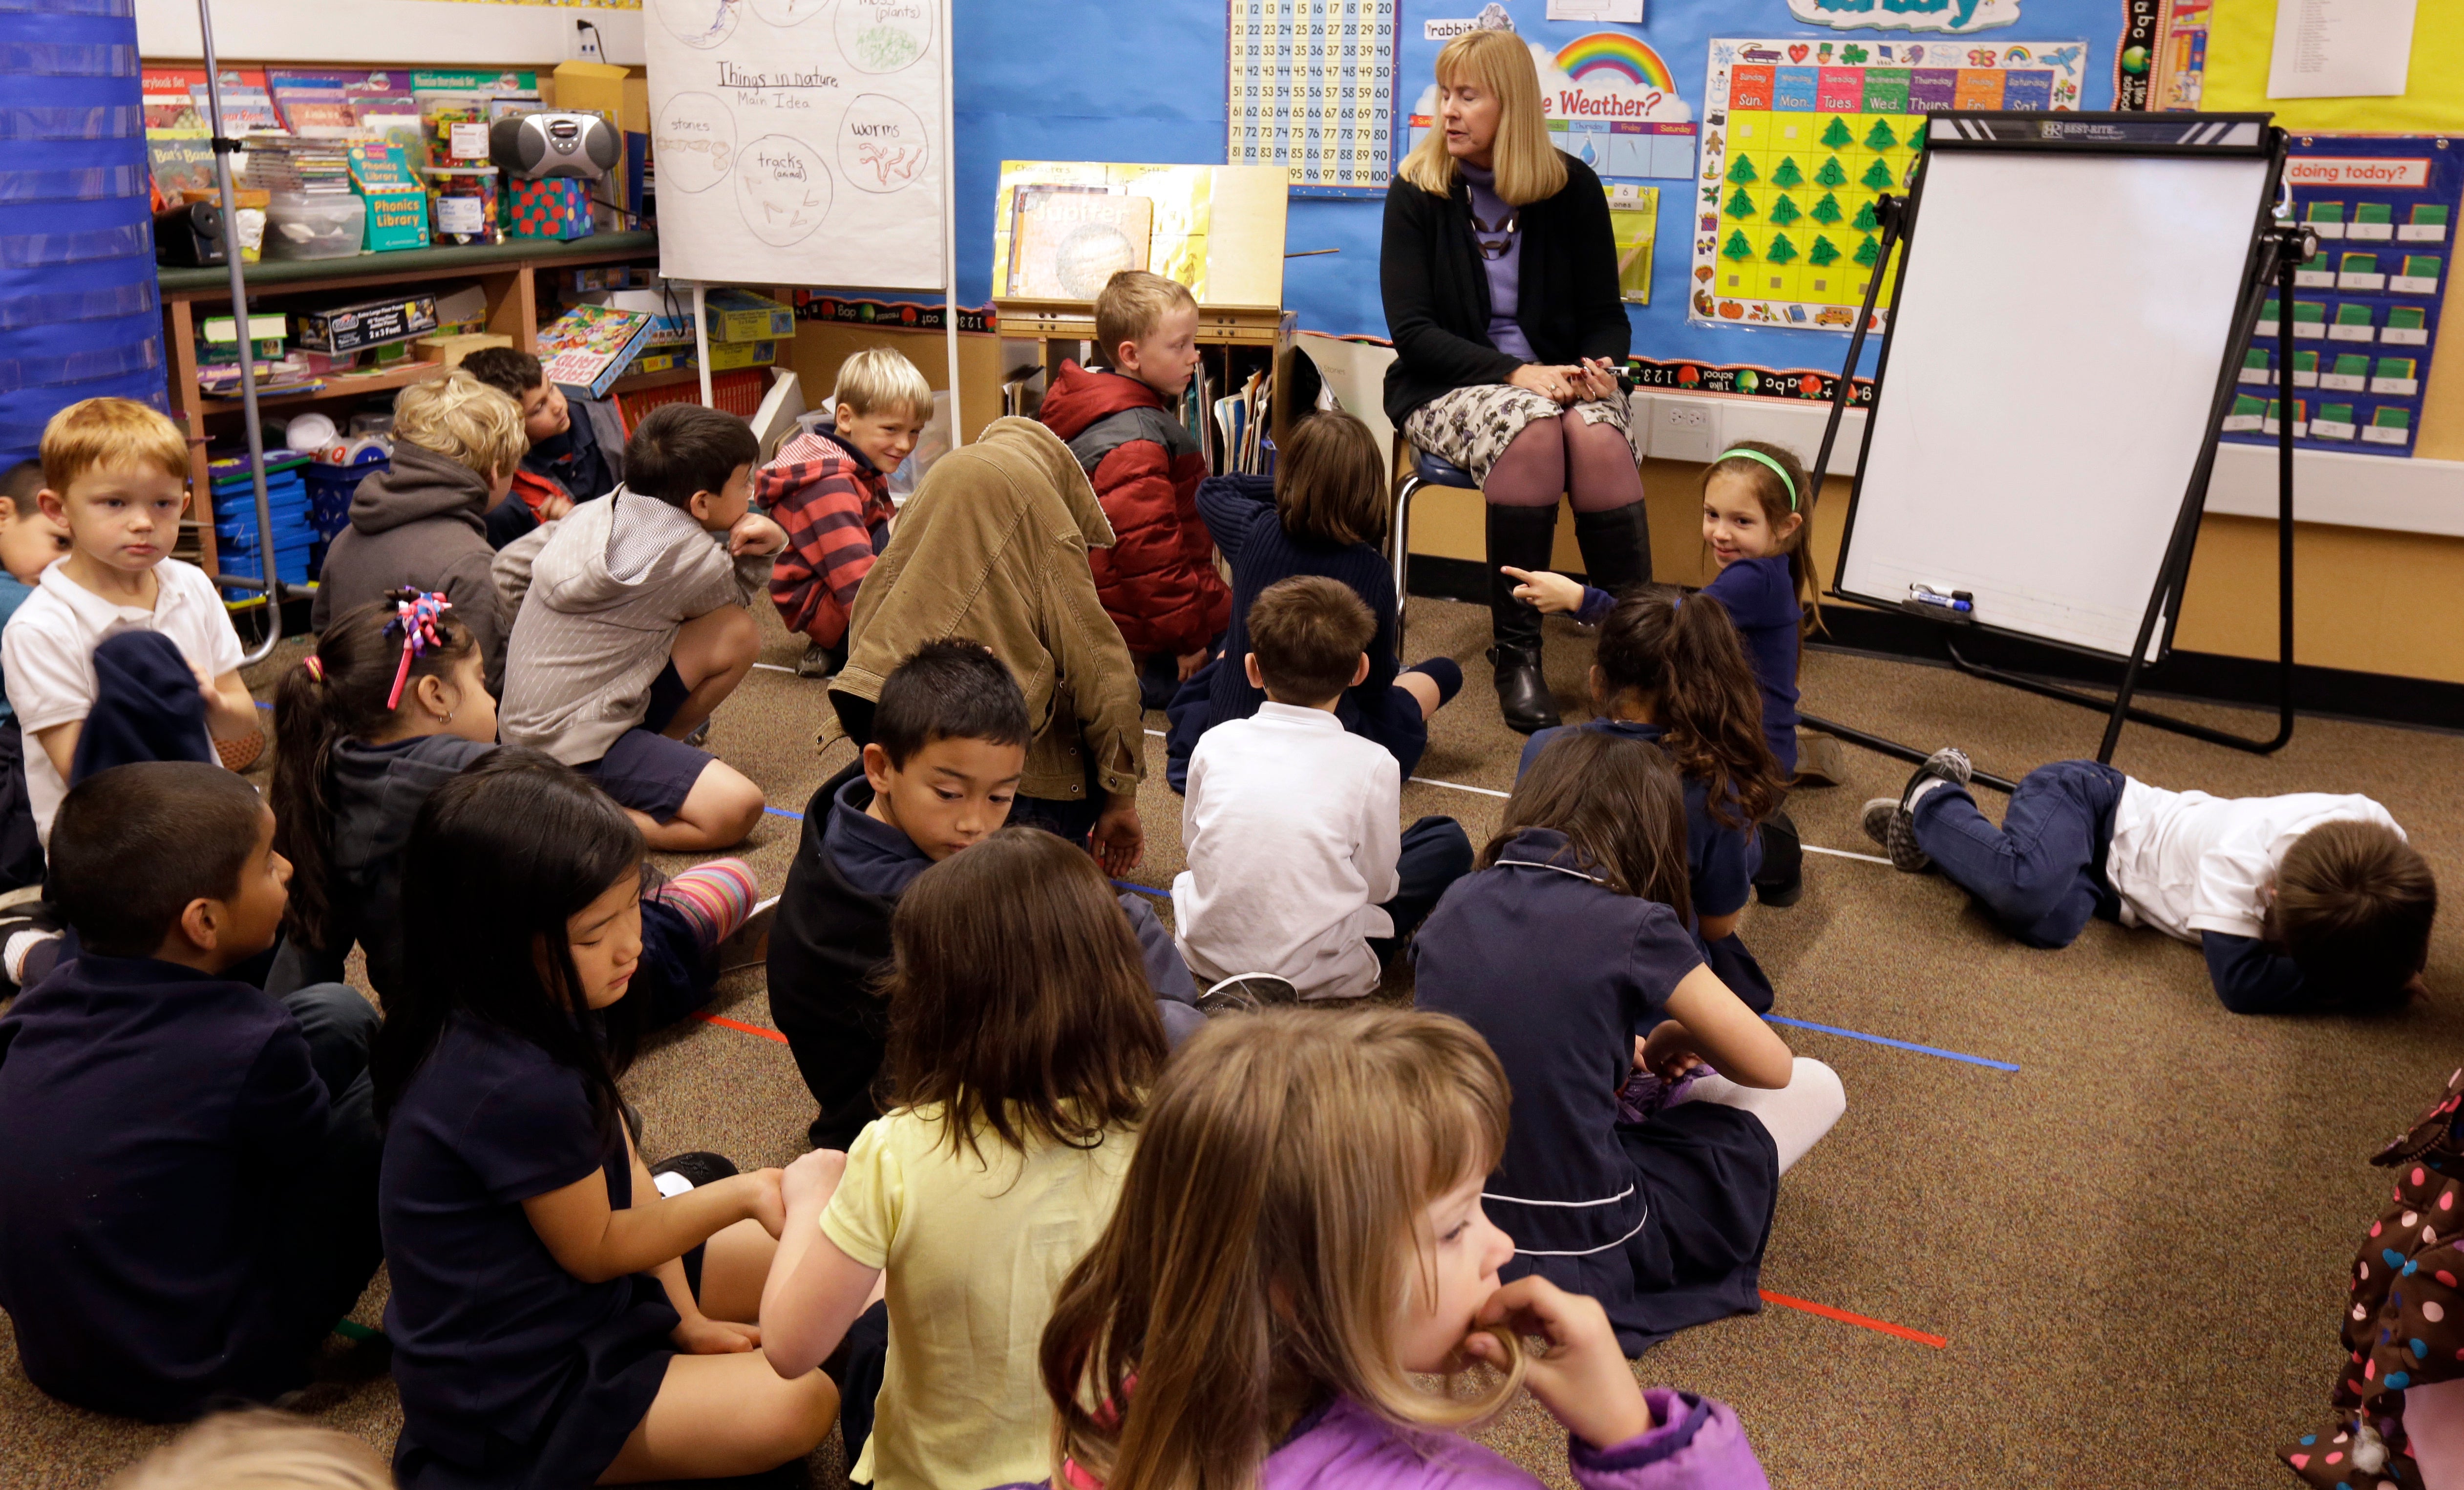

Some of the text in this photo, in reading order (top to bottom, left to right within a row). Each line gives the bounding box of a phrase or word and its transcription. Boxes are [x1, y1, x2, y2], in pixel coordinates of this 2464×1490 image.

[875, 4, 920, 23] (plants)
[1236, 2, 1392, 15] 11 12 13 14 15 16 17 18 19 20
[1234, 24, 1391, 35] 21 22 23 24 25 26 27 28 29 30
[1431, 22, 1473, 37] rabbit
[1234, 45, 1391, 56] 31 32 33 34 35 36 37 38 39 40
[716, 61, 839, 95] Things in nature
[1233, 65, 1390, 78] 41 42 43 44 45 46 47 48 49 50
[142, 76, 185, 90] orybook Set
[1739, 73, 2049, 89] Sunday Monday Tuesday Wednesday Thursday Friday Saturday
[738, 91, 810, 109] Main Idea
[1233, 86, 1389, 99] 51 52 53 54 55 56 57 58 59 60
[2134, 86, 2147, 105] like
[1560, 89, 1661, 116] Weather?
[1739, 93, 1763, 106] Sun.
[1779, 94, 1810, 107] Mon.
[1823, 95, 1855, 109] Tues.
[1870, 97, 1900, 110] Wed.
[671, 120, 710, 132] stones
[851, 122, 900, 137] worms
[1575, 122, 1604, 130] Thursday
[1660, 124, 1692, 134] Saturday
[1834, 127, 1887, 145] 1 2
[153, 148, 183, 163] Bat's
[757, 152, 804, 169] tracks
[361, 161, 398, 171] Phonics
[1015, 164, 1070, 173] Characters
[1736, 162, 1883, 185] 6 7 8 9
[2291, 163, 2407, 183] doing today?
[364, 172, 398, 183] Library
[773, 168, 807, 183] (animal)
[1290, 168, 1388, 181] 95 96 97 98 99 100
[1622, 187, 1629, 196] 6
[374, 199, 420, 213] Phonics
[1031, 198, 1132, 225] Jupiter
[1734, 195, 1876, 227] 13 14 15 16
[376, 214, 420, 228] Library
[1729, 238, 1878, 260] 20 21 22 23
[838, 304, 856, 320] dog
[921, 315, 939, 326] cat
[555, 355, 606, 370] LAND
[548, 367, 595, 383] CAND
[1643, 369, 1673, 383] 1 2 3
[1703, 370, 1734, 382] school
[1708, 381, 1730, 391] I like
